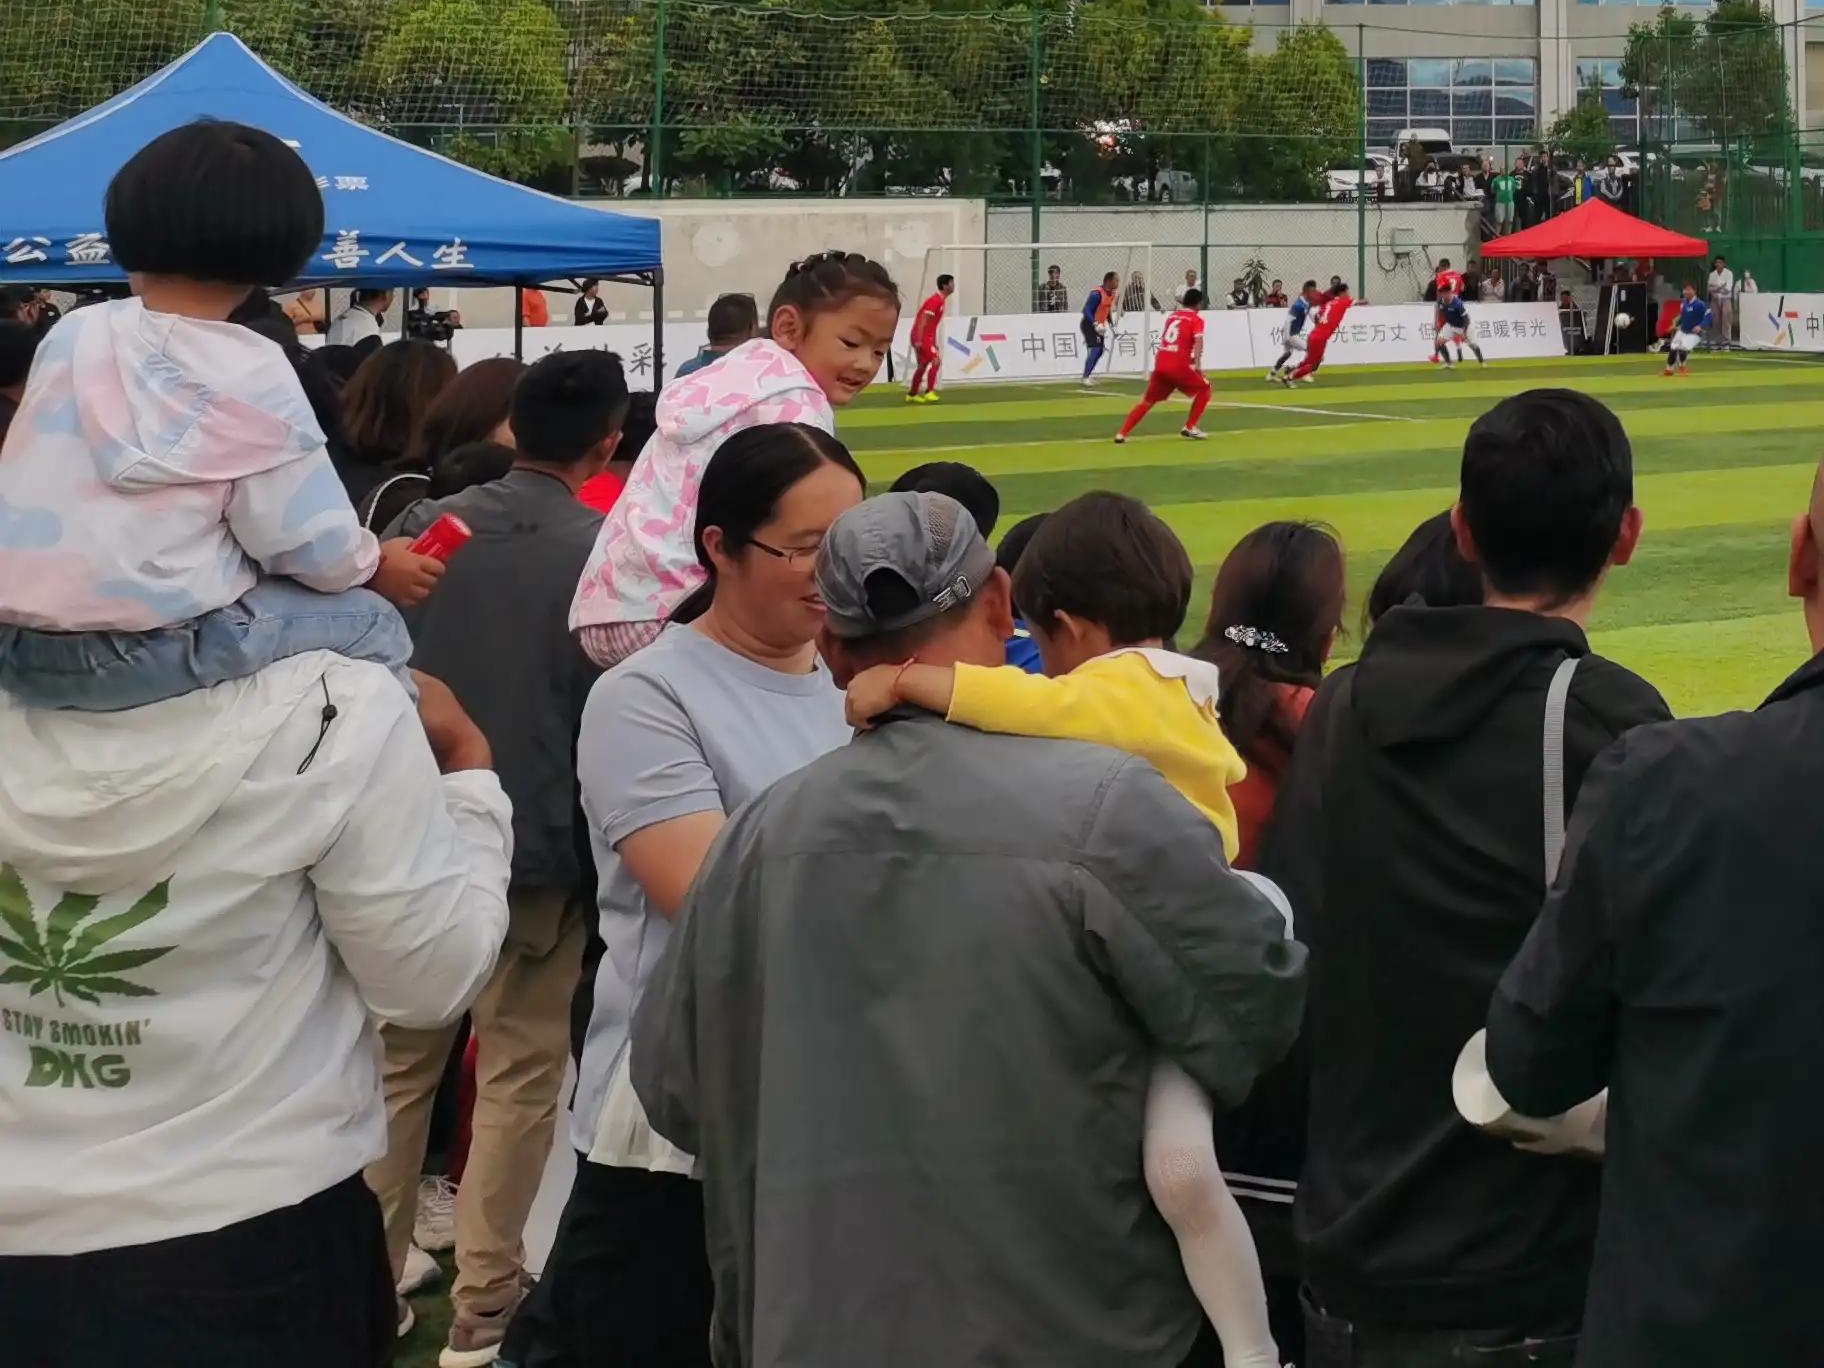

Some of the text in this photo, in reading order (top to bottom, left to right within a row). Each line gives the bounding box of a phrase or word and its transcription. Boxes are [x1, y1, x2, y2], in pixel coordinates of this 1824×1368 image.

[322, 229, 475, 270] 善人生
[1164, 319, 1182, 344] 6
[1418, 319, 1548, 342] 但温暖有光
[2, 1007, 43, 1040] STAY
